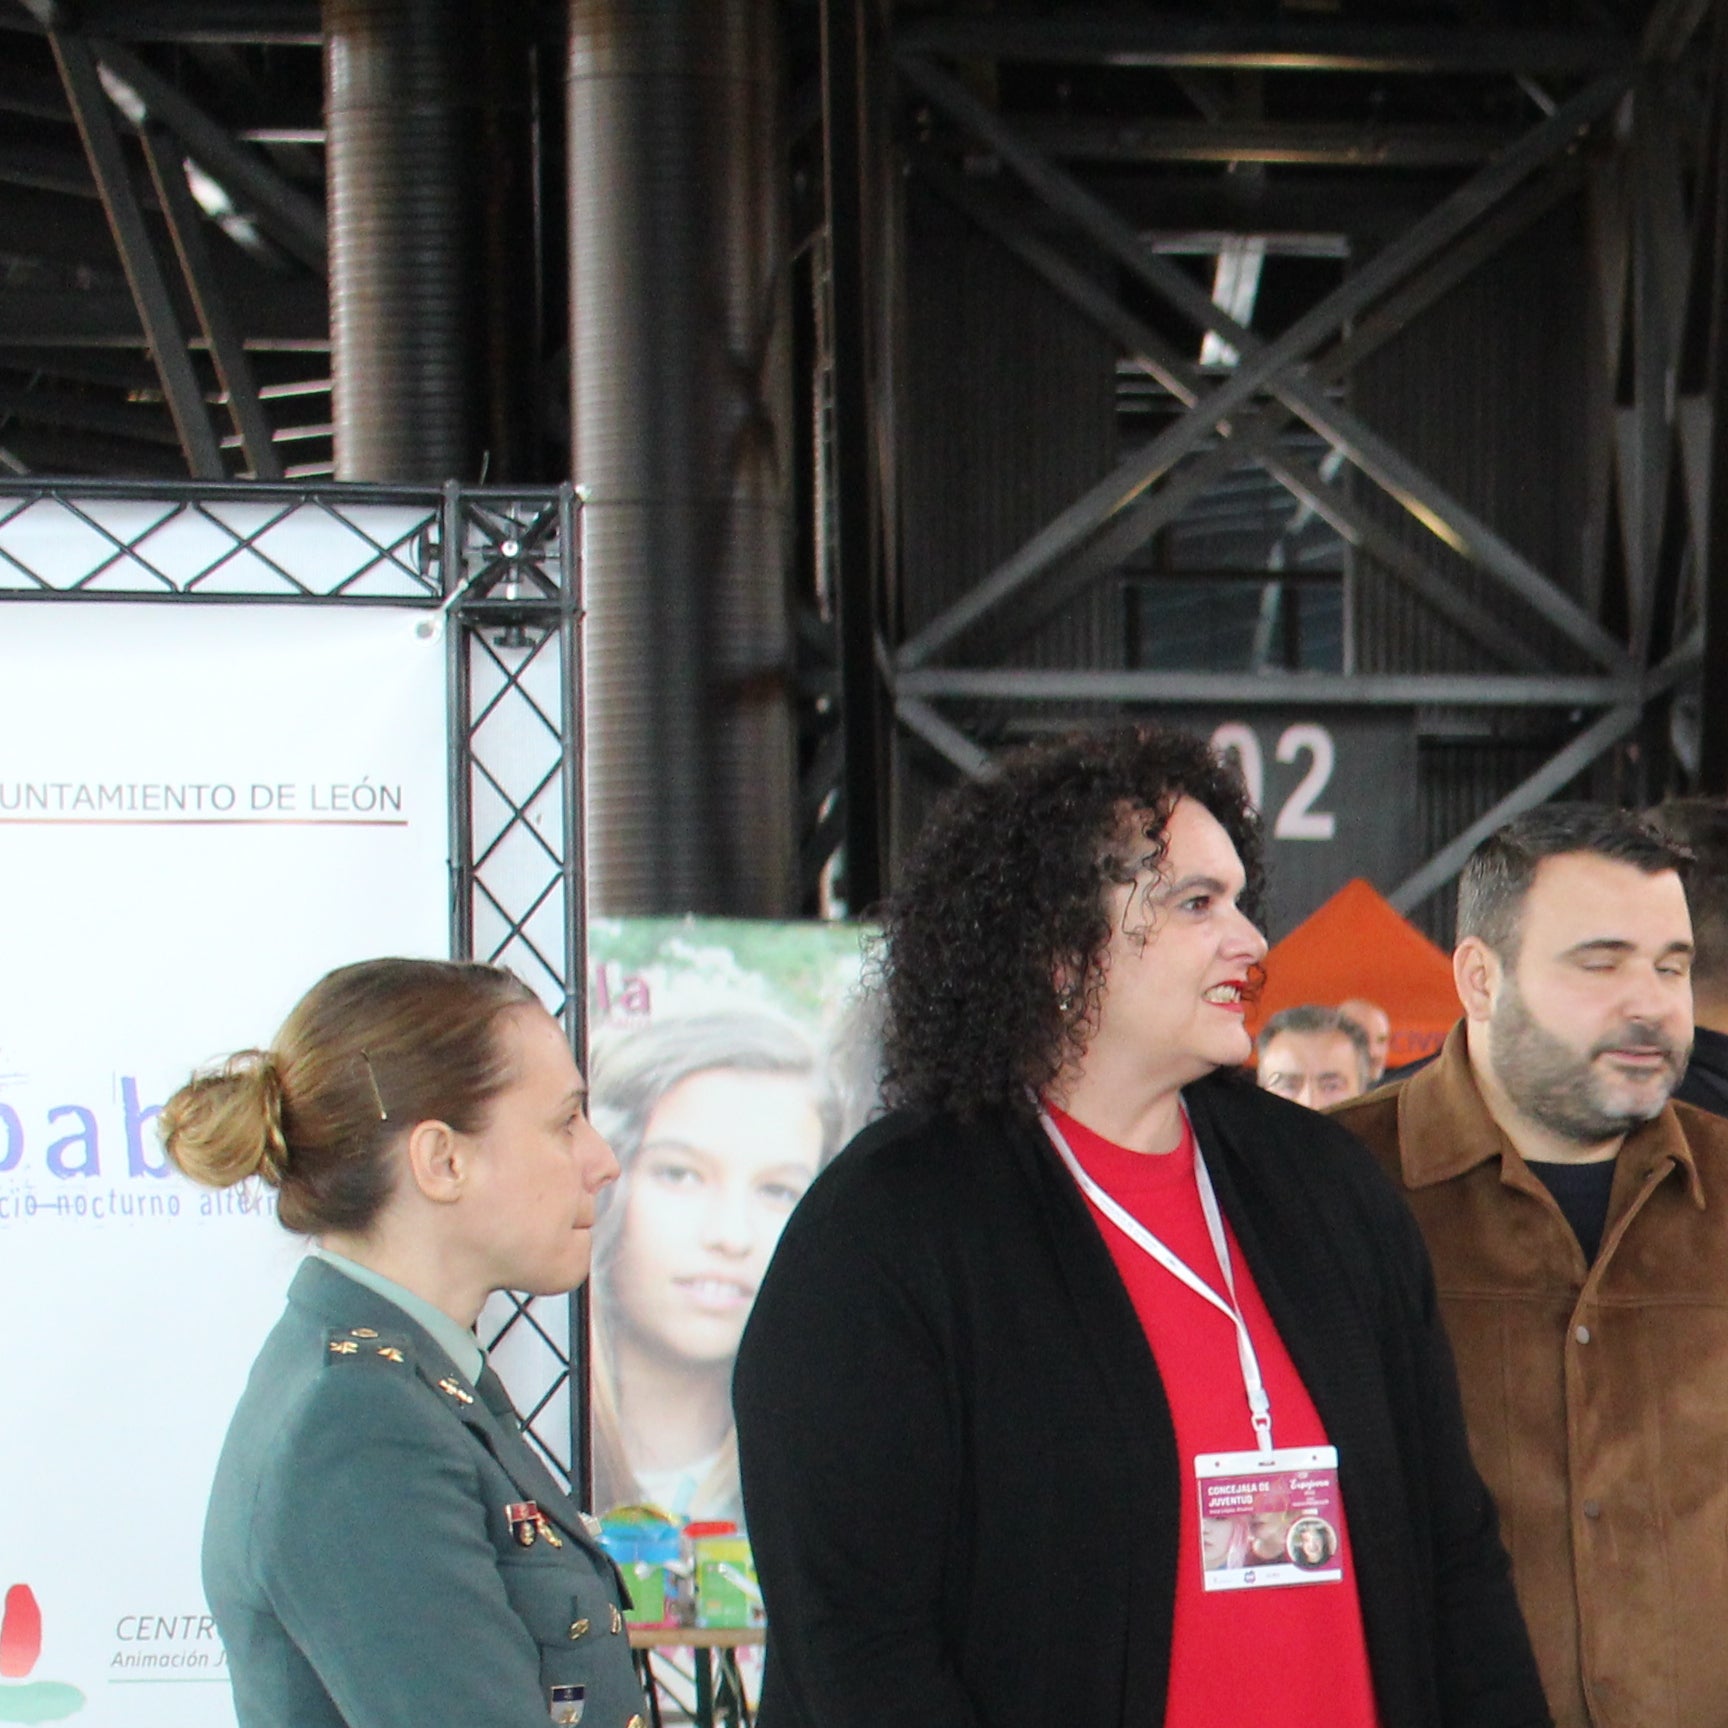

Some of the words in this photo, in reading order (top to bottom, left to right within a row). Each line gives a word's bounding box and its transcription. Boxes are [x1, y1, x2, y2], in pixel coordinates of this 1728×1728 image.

[250, 784, 296, 811] DE
[310, 776, 402, 811] LEÓN
[110, 1651, 209, 1668] Animación
